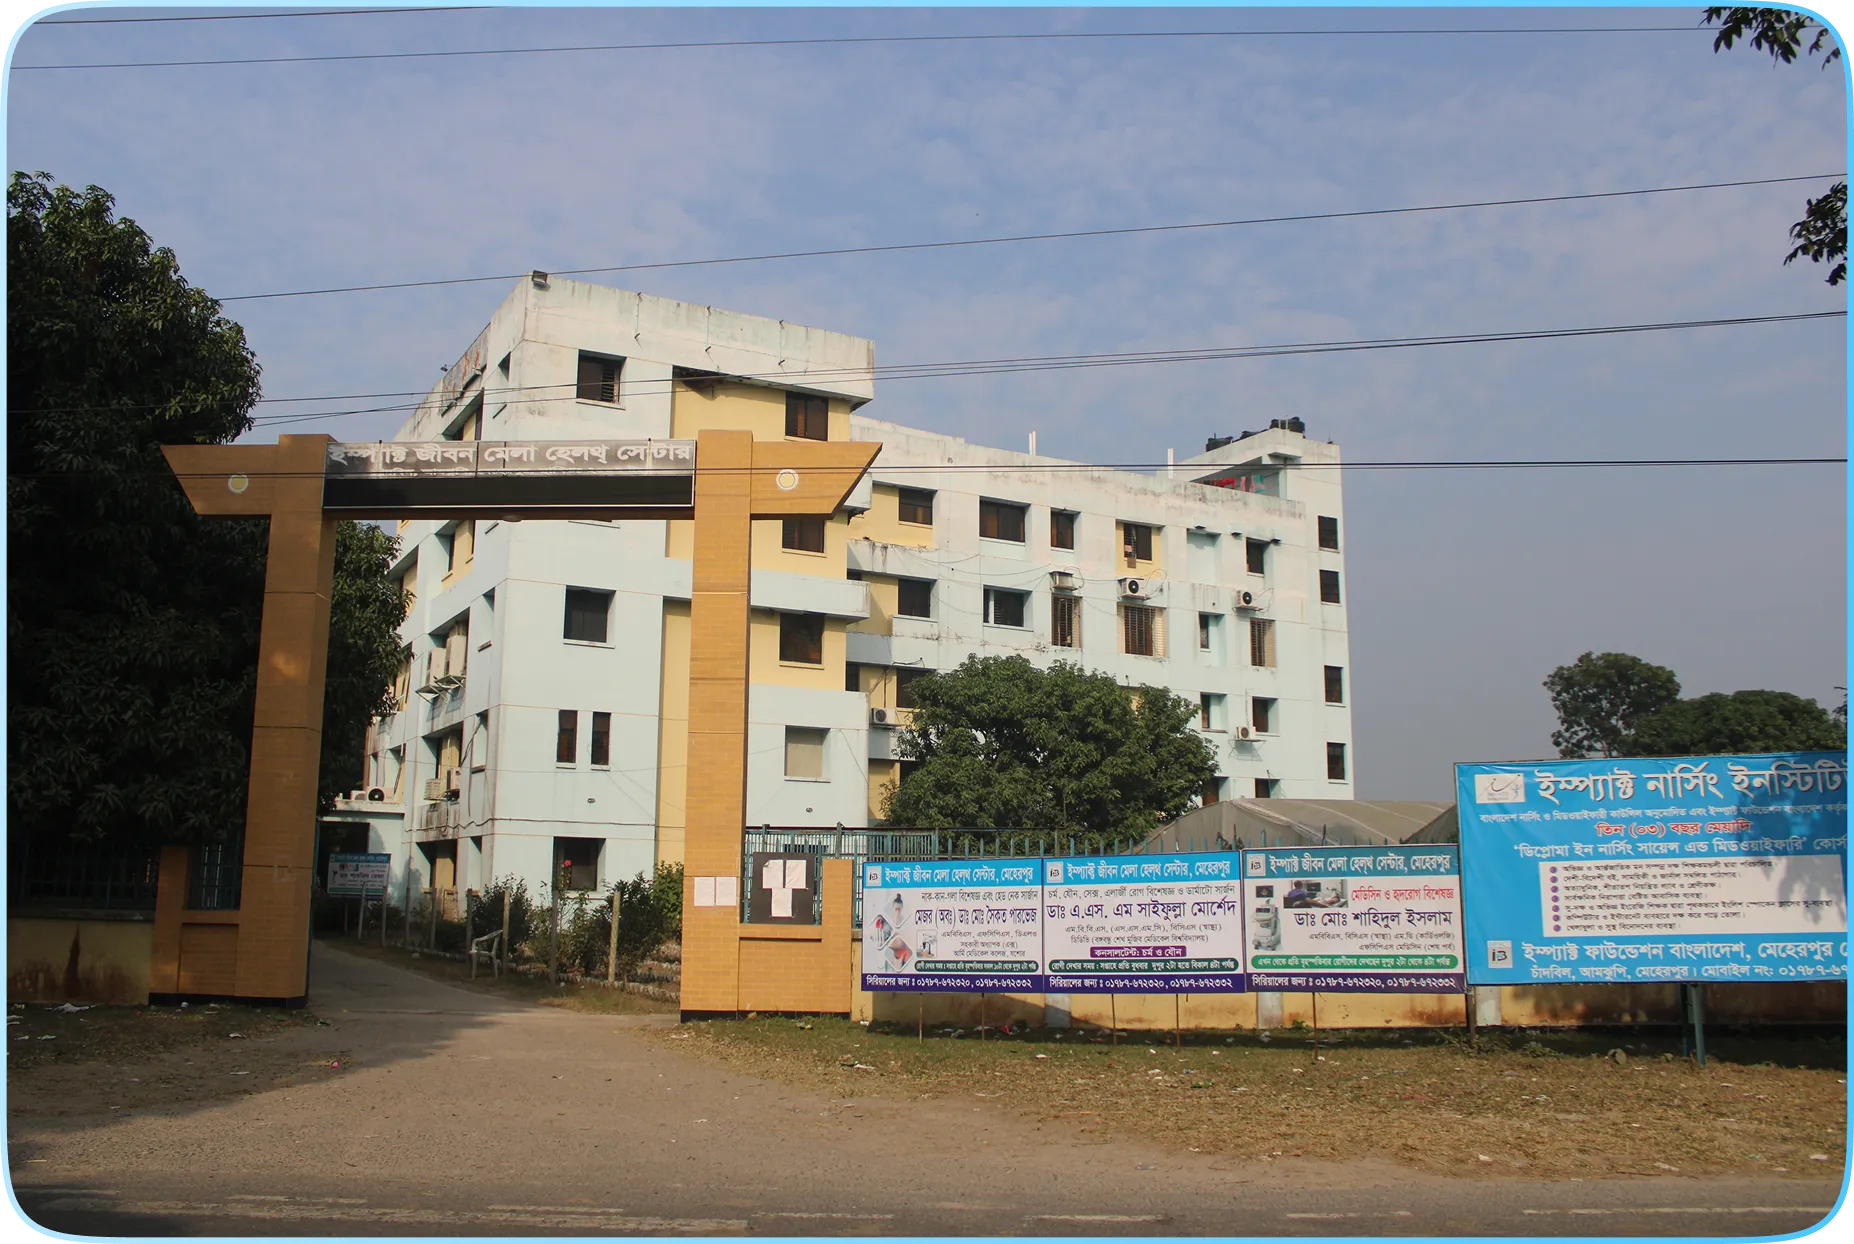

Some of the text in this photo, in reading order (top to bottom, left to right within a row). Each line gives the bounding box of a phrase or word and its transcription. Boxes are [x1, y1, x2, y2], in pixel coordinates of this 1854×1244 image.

[412, 442, 475, 464] জীবন
[484, 444, 537, 463] মেলা
[1642, 762, 1724, 800] নার্সিং
[1520, 811, 1542, 821] নার্সিং
[1595, 822, 1626, 837] তিন
[1629, 822, 1666, 838] (০৩)
[1670, 823, 1701, 836] বছর
[1573, 842, 1594, 857] ইন
[1598, 839, 1634, 856] নার্সিং
[1098, 860, 1118, 879] জীবন
[1120, 864, 1138, 879] মেলা
[1164, 860, 1193, 879] সেন্টার,
[1195, 861, 1230, 878] মেহেরপুর
[1301, 853, 1325, 873] জীবন
[1327, 857, 1347, 872] মেলা
[1377, 852, 1408, 873] সেন্টার,
[1411, 855, 1450, 873] মেহেরপুর
[913, 865, 931, 882] জীবন
[934, 869, 950, 882] মেলা
[973, 865, 999, 884] সেন্টার,
[1001, 866, 1033, 884] মেহেরপুর
[982, 892, 992, 901] এবং
[1008, 891, 1019, 901] নেক
[1129, 887, 1144, 897] রোগ
[1215, 884, 1235, 894] সার্জন
[1352, 886, 1381, 901] মেডিসিন
[1385, 890, 1390, 900] ও
[1393, 888, 1420, 902] হৃদরোগ
[915, 909, 933, 925] মেজর
[958, 909, 968, 924] ডাঃ
[971, 908, 984, 925] মোঃ
[987, 905, 1007, 924] সৈকত
[1010, 907, 1037, 925] পারভেজ
[1046, 895, 1236, 921] ডাঃ এ.এস. এম সাইফুল্লা মোর্শেদ
[1294, 908, 1452, 929] ডাঃ মোঃ শাহিদুল ইসলাম
[1171, 923, 1196, 931] বিসিএস
[1144, 935, 1169, 943] মেডিকেল
[1345, 932, 1368, 940] বিসিএস
[1142, 947, 1155, 956] চর্ম
[1165, 947, 1182, 956] যৌন
[1397, 942, 1422, 951] মেডিসিন
[1583, 940, 1664, 960] ফাউন্ডেশন
[1667, 941, 1751, 962] বাংলাদেশ,
[1758, 941, 1833, 961] মেহেরপুর
[1530, 965, 1576, 980] চাঁদবিল,
[1702, 963, 1750, 977] মোবাইল
[898, 976, 909, 986] জন্য
[1083, 978, 1097, 988] জন্য
[1291, 976, 1306, 987] জন্য
[1387, 976, 1455, 988] ০১৭৮৭-৬৭২৩৩২
